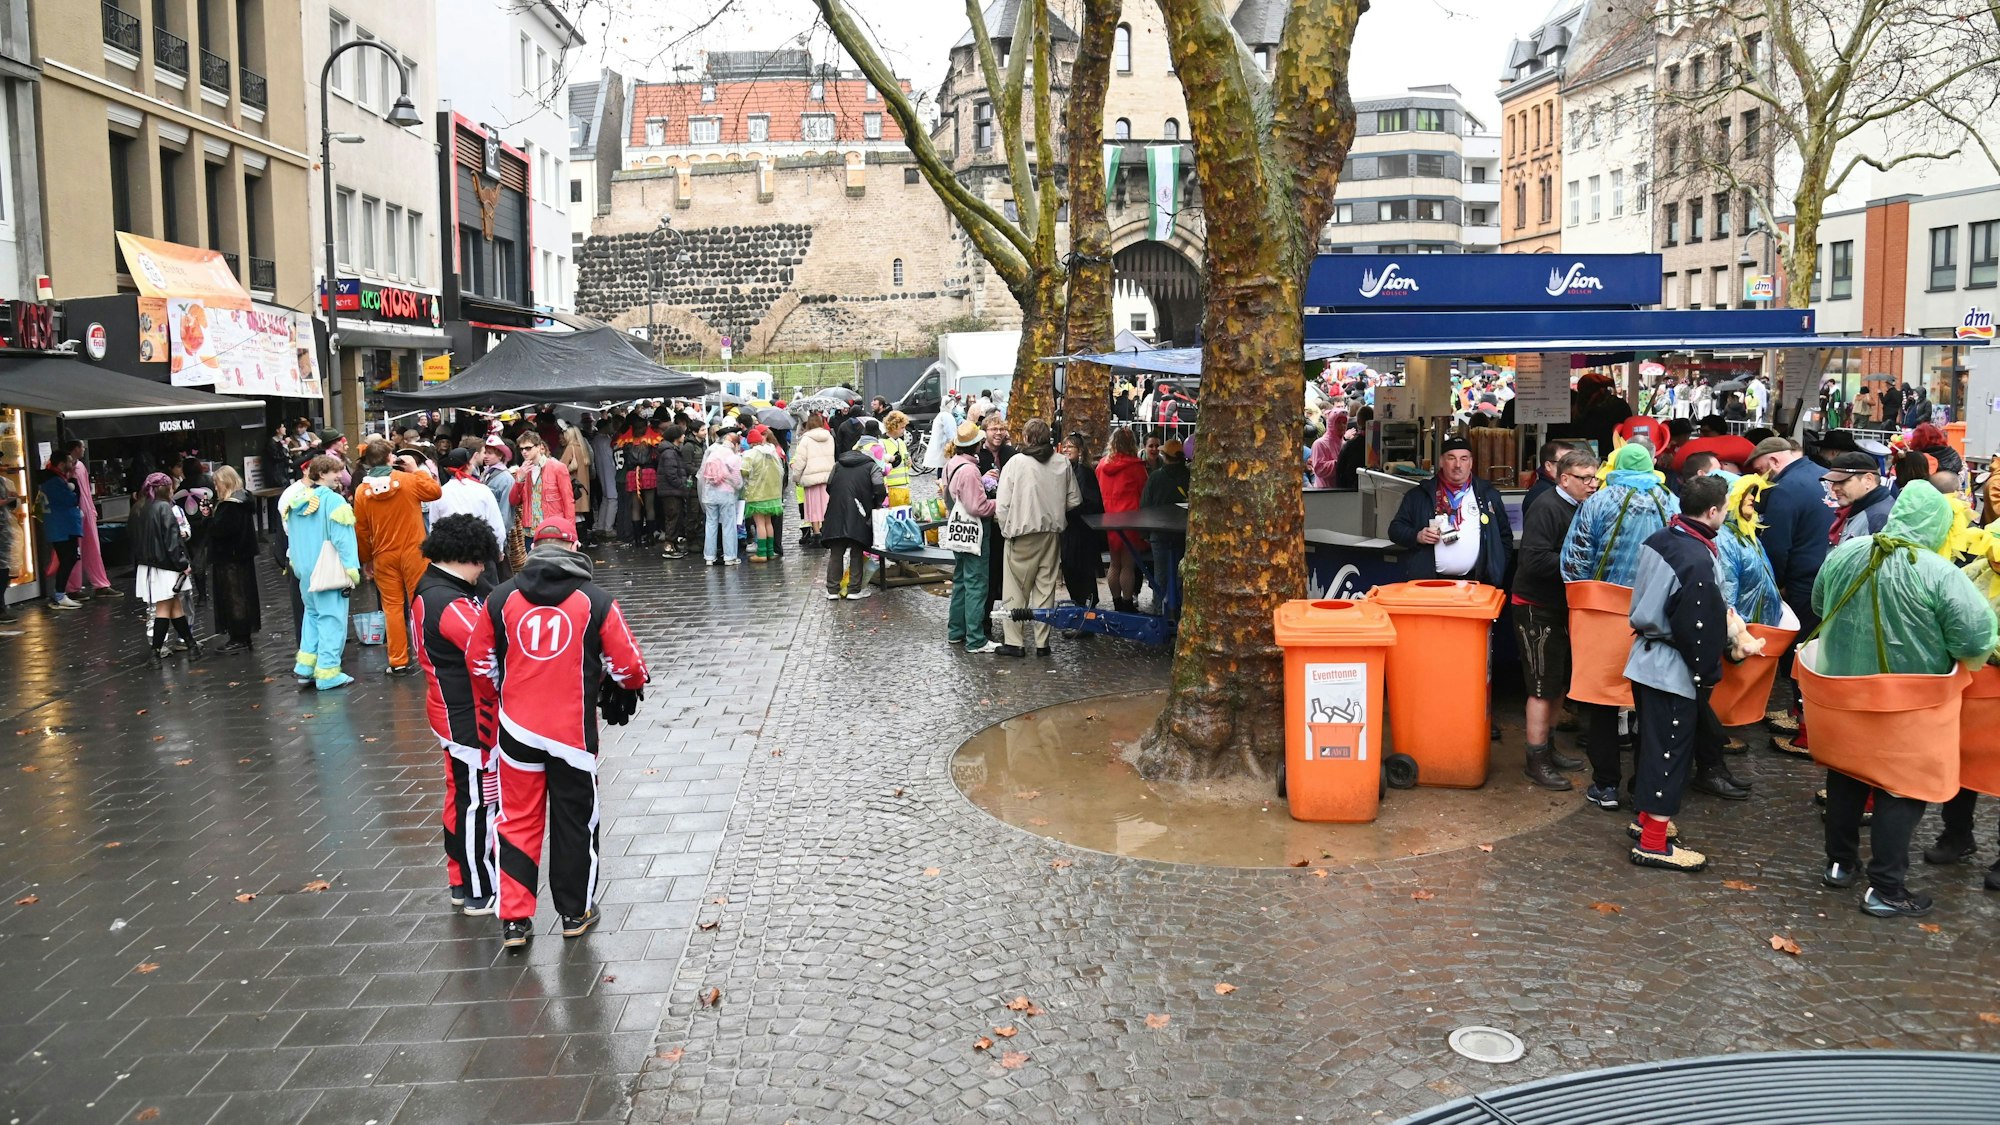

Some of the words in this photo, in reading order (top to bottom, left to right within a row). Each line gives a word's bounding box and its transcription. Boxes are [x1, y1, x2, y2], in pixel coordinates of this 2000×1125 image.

[1359, 263, 1419, 298] Sion
[1545, 262, 1603, 296] Sion
[1754, 281, 1770, 290] dm
[1964, 307, 1990, 326] dm
[159, 420, 181, 432] KIOSK
[182, 419, 196, 430] Nr.1
[949, 524, 979, 536] BONN
[526, 615, 562, 651] 11
[1312, 668, 1358, 681] Eventtonne
